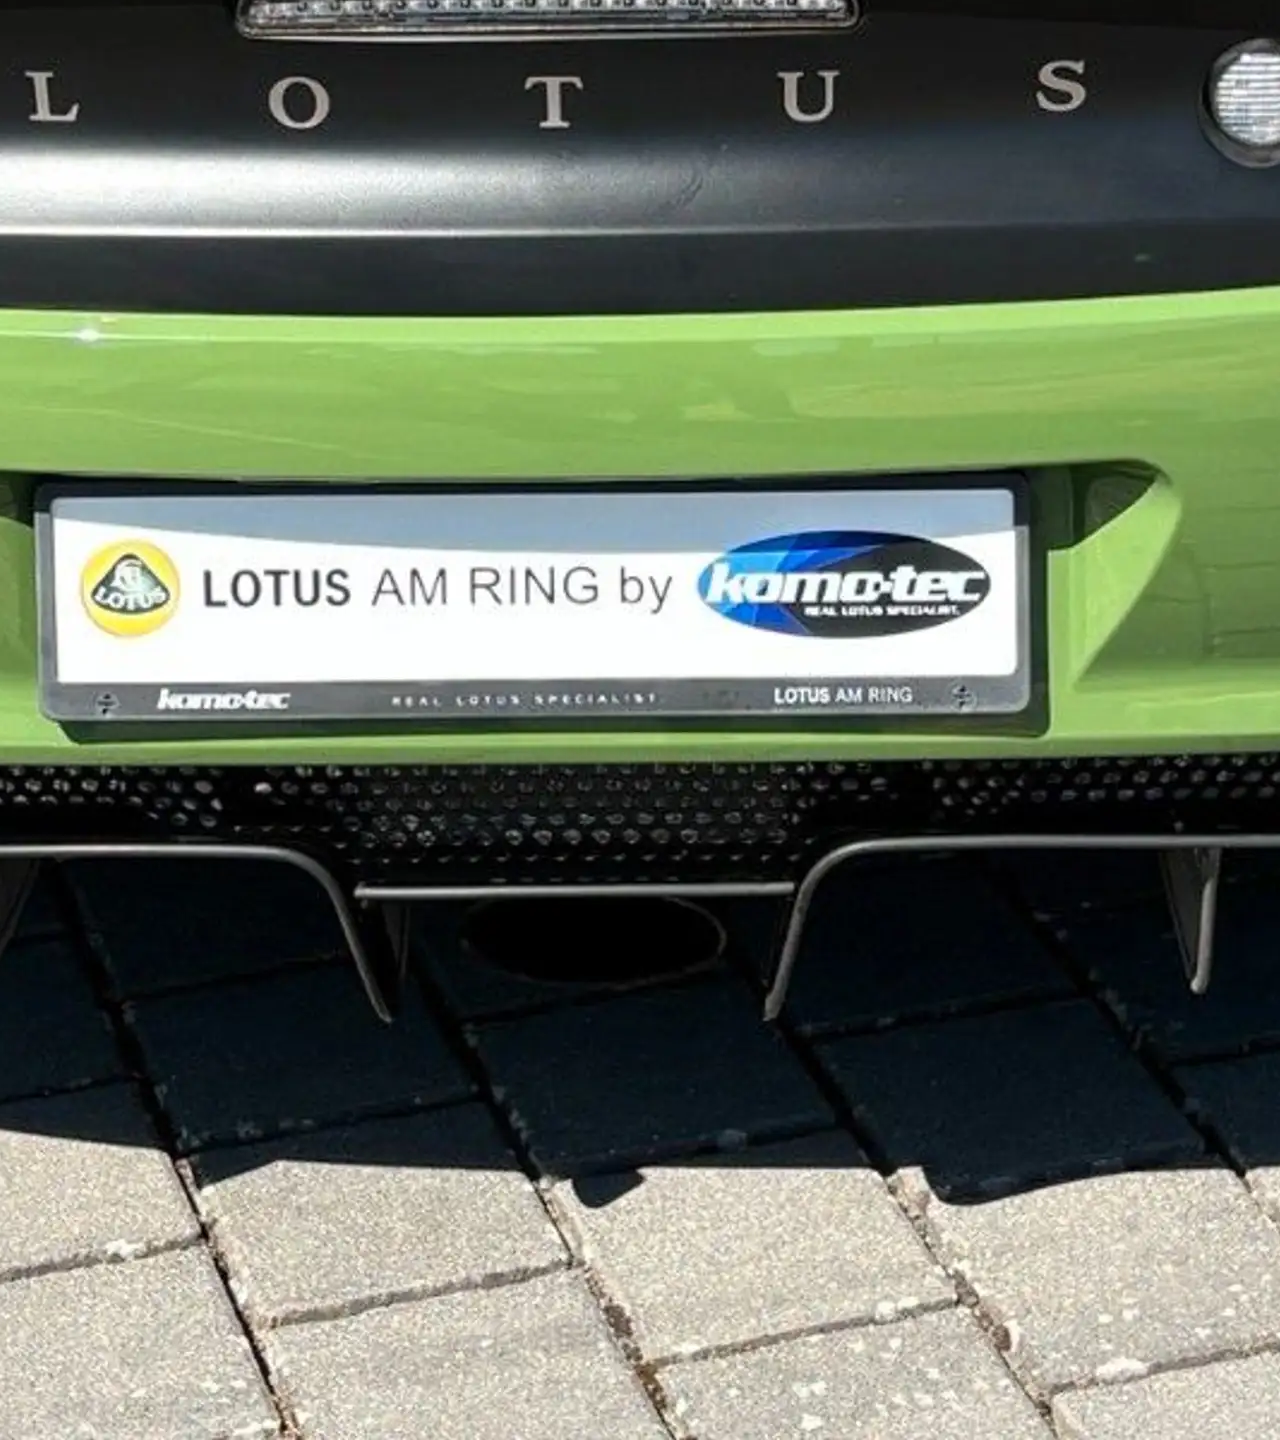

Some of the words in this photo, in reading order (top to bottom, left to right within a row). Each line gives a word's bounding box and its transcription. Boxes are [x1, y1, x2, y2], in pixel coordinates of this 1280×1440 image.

[24, 58, 1089, 129] LOTUS
[94, 585, 167, 611] LOTUS
[202, 569, 351, 608] LOTUS
[371, 567, 448, 607] AM
[468, 565, 599, 606] RING
[620, 565, 674, 615] by
[804, 605, 838, 617] REAL
[842, 605, 884, 617] LOTUS
[391, 695, 442, 707] REAL
[455, 694, 521, 707] LOTUS
[533, 692, 657, 706] SPECIALIST
[773, 686, 831, 705] LOTUS
[835, 686, 863, 704] AM
[867, 685, 914, 704] RING
